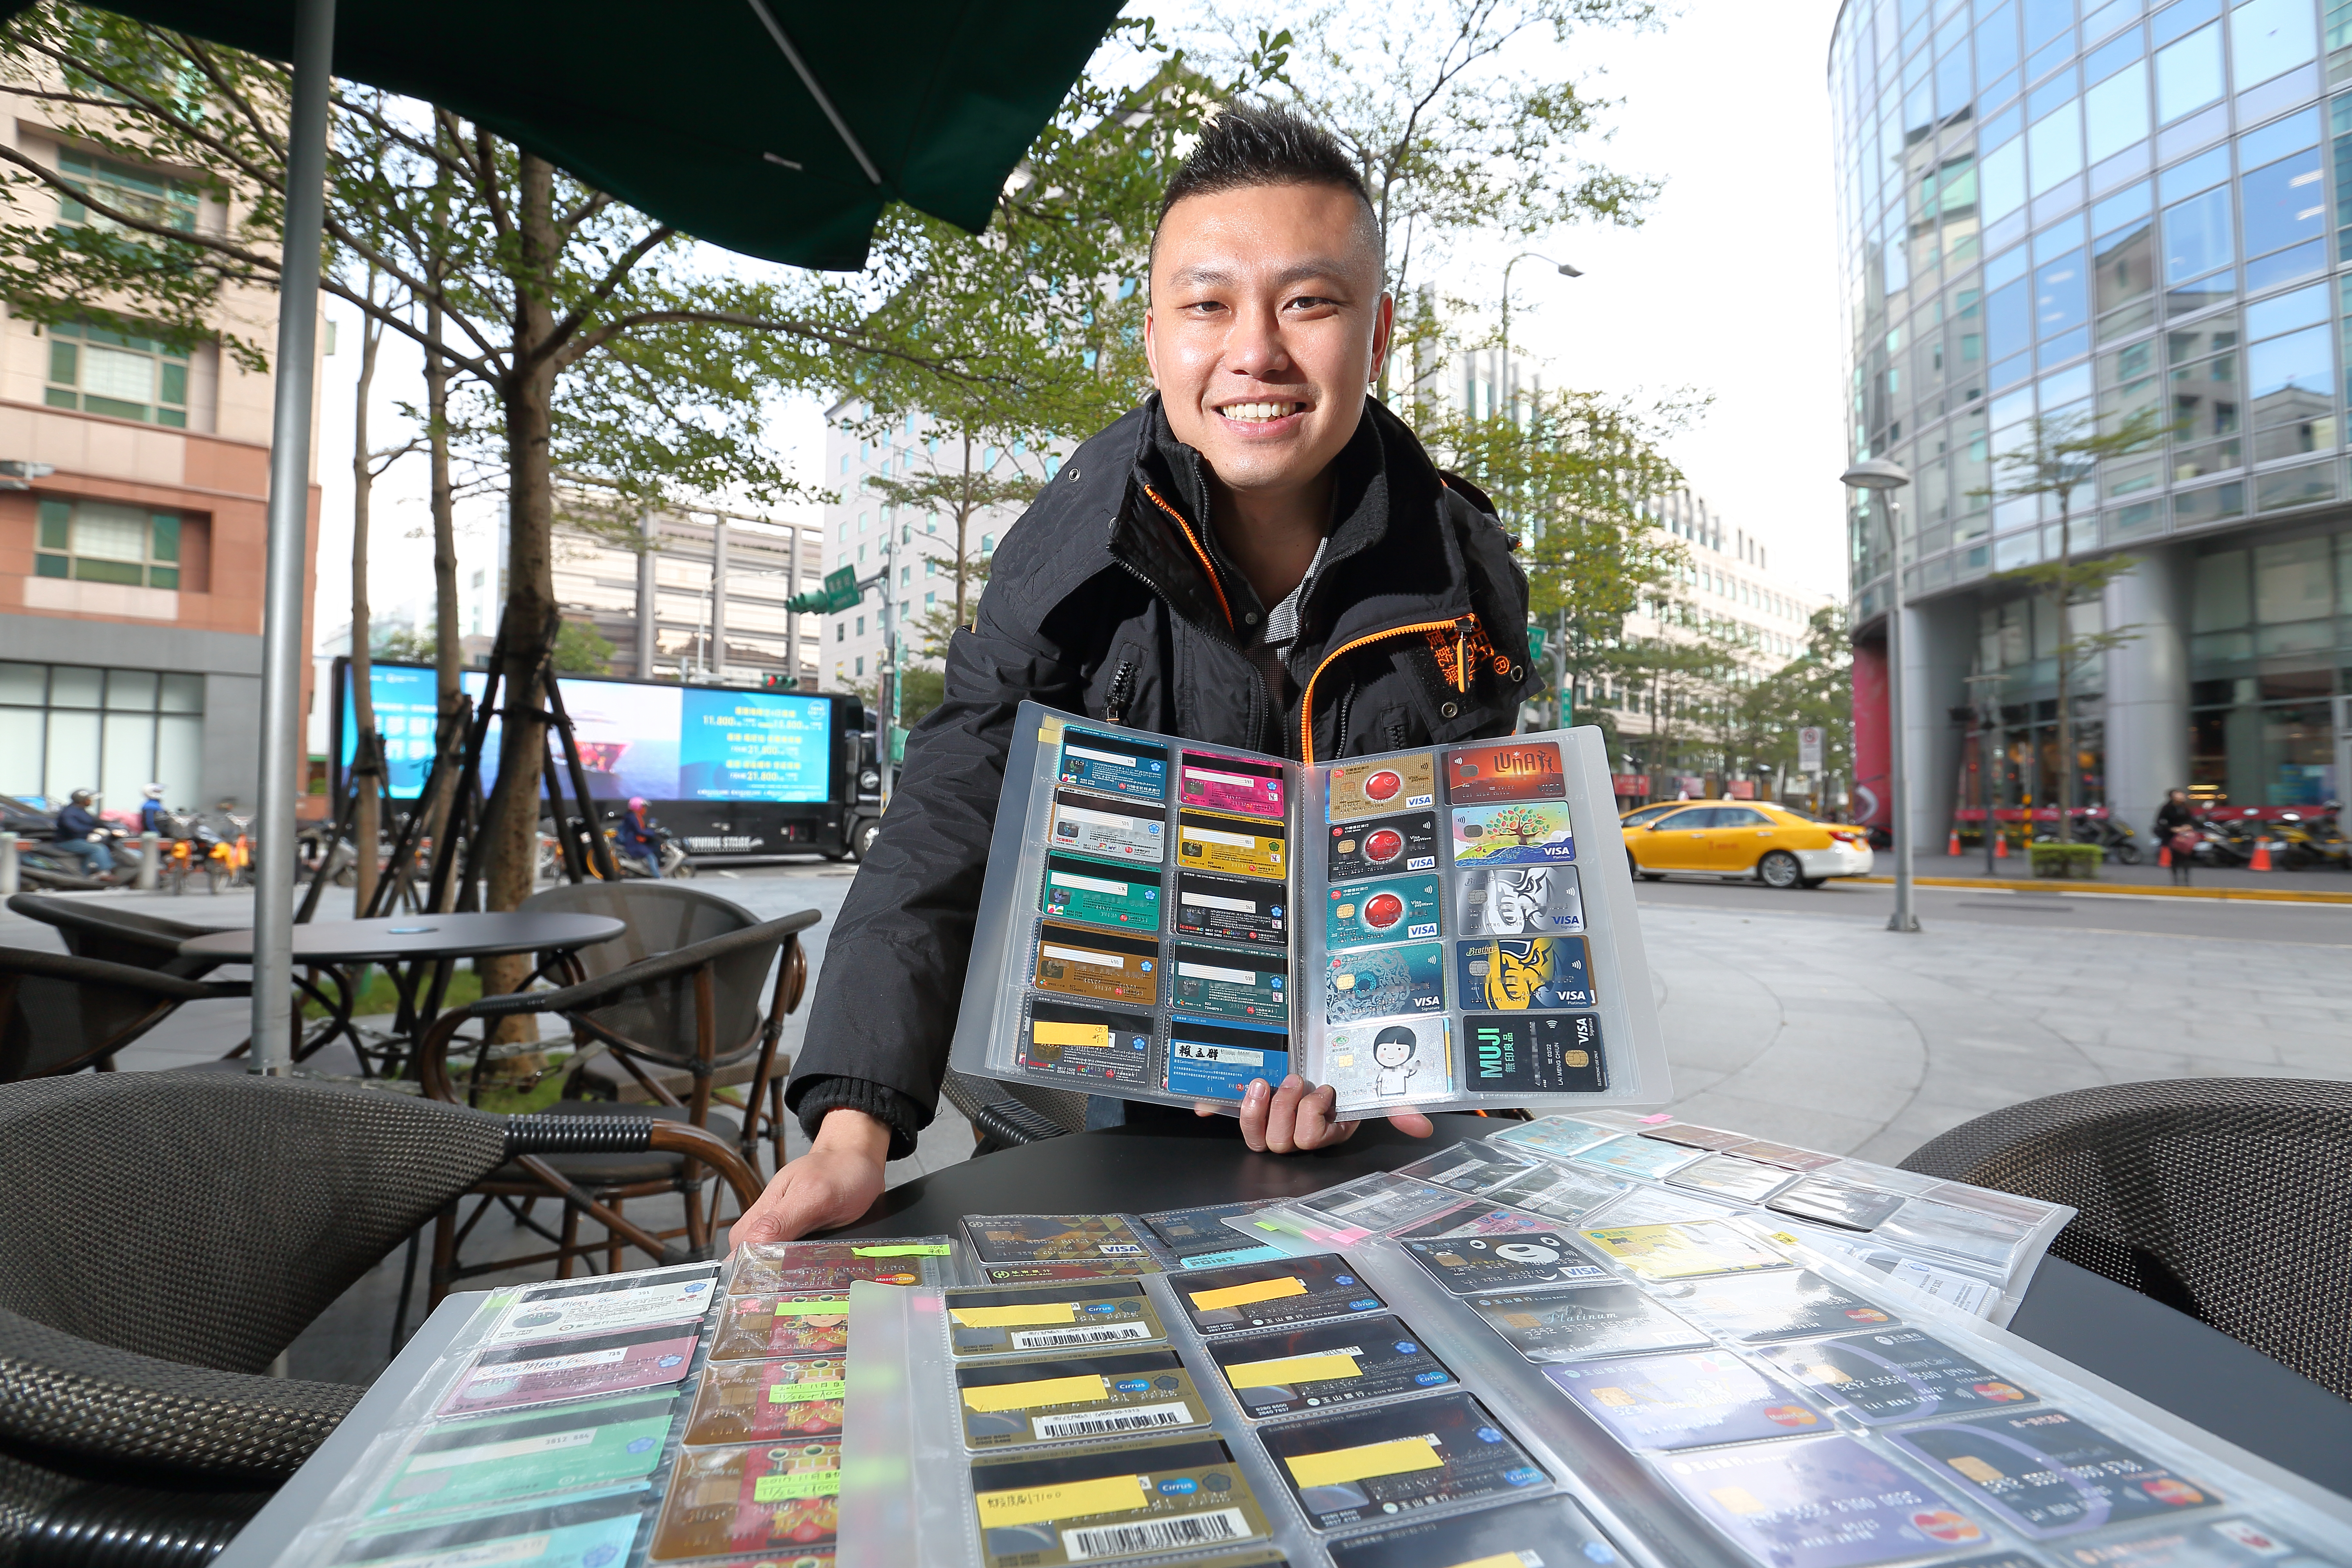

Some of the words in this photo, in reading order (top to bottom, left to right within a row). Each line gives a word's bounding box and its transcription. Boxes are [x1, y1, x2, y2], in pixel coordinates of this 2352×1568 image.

[1537, 784, 1562, 792] VISA
[1408, 796, 1431, 806] VISA
[1543, 847, 1570, 855] VISA
[1410, 858, 1433, 868] VISA
[1551, 915, 1579, 924] VISA
[1411, 925, 1435, 935] VISA
[1466, 945, 1498, 957] Brothers
[1555, 991, 1586, 1000] VISA
[1412, 996, 1440, 1007] VISA
[1576, 1018, 1589, 1045] VISA
[1477, 1028, 1503, 1078] MUJI
[1503, 1032, 1516, 1073] 無印良品
[1147, 1216, 1189, 1225] POINT
[1189, 1256, 1236, 1266] POINT
[1566, 1267, 1604, 1275] VISA
[1493, 1296, 1533, 1305] 玉山銀行
[1265, 1314, 1304, 1324] 玉山銀行
[1541, 1312, 1619, 1324] Platinum
[1660, 1333, 1704, 1344] VISA
[1928, 1356, 1952, 1366] Card
[1581, 1365, 1627, 1377] 玉山銀行
[1419, 1374, 1443, 1383] Cirrus
[1321, 1391, 1365, 1404] 玉山銀行
[1768, 1411, 1812, 1421] MasterCard
[1510, 1470, 1538, 1481] Cirrus
[1162, 1483, 1192, 1492] Cirrus
[1399, 1493, 1450, 1510] 玉山銀行
